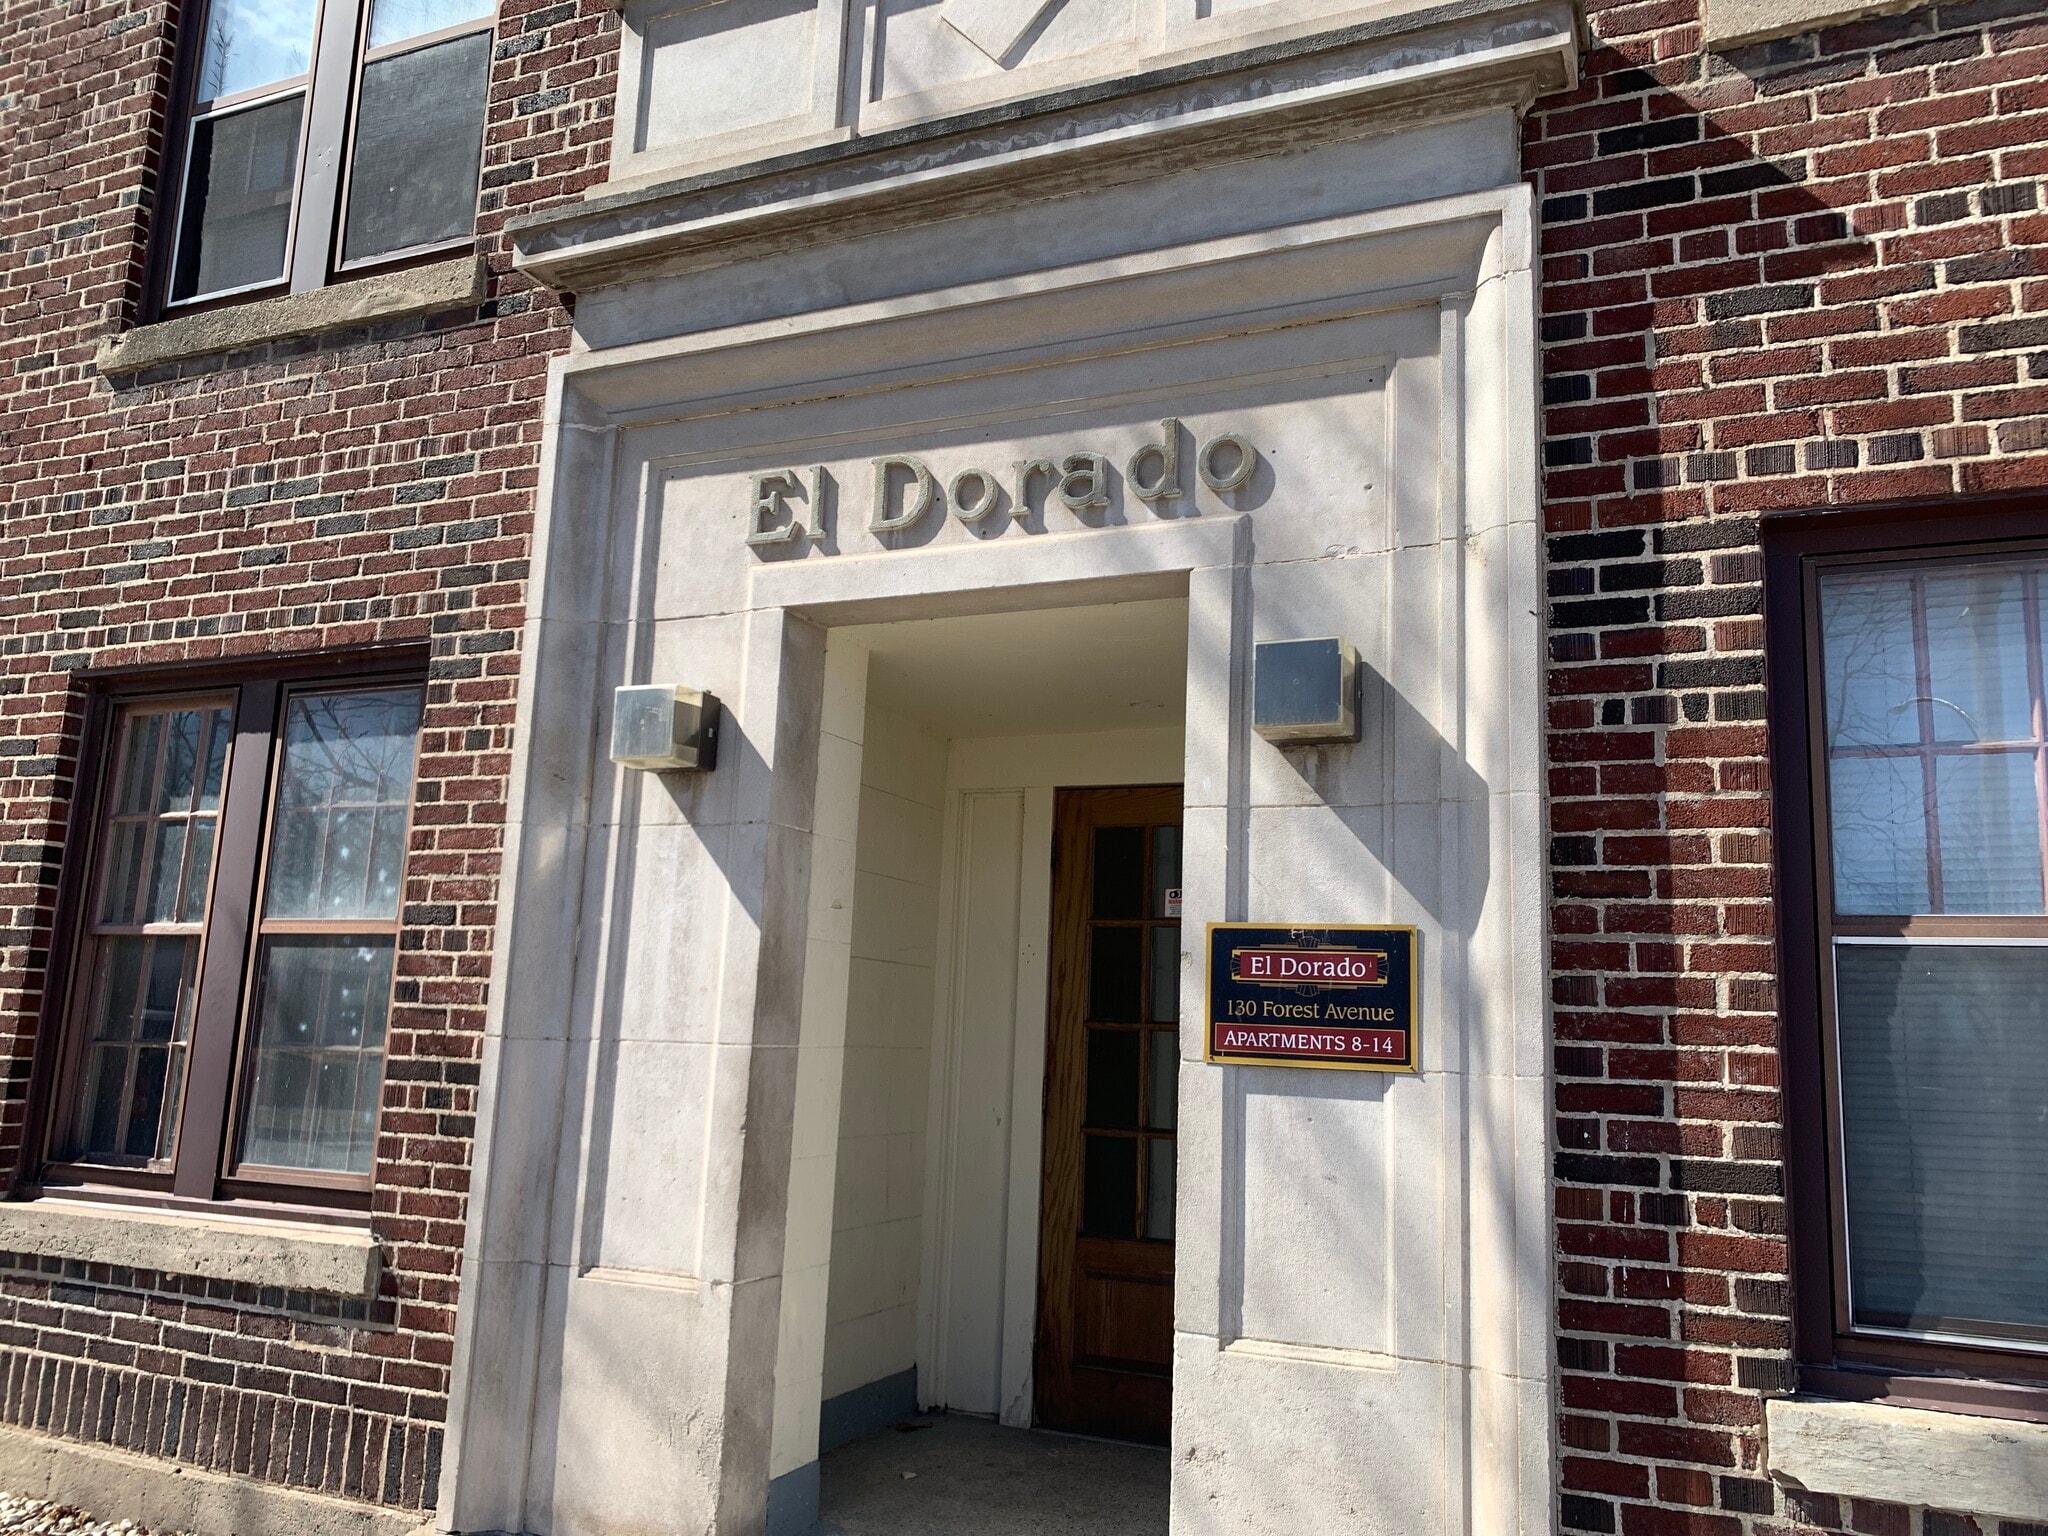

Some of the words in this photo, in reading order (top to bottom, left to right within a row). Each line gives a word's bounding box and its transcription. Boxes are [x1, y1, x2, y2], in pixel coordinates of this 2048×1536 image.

[745, 465, 828, 546] El
[868, 417, 1257, 533] Dorado
[1250, 956, 1271, 975] El
[1280, 957, 1366, 978] Dorado
[1227, 999, 1257, 1016] 130
[1262, 1001, 1320, 1019] Forest
[1325, 1003, 1395, 1021] Avenue
[1224, 1030, 1346, 1050] APARTMENTS
[1351, 1036, 1393, 1053] 8-14
